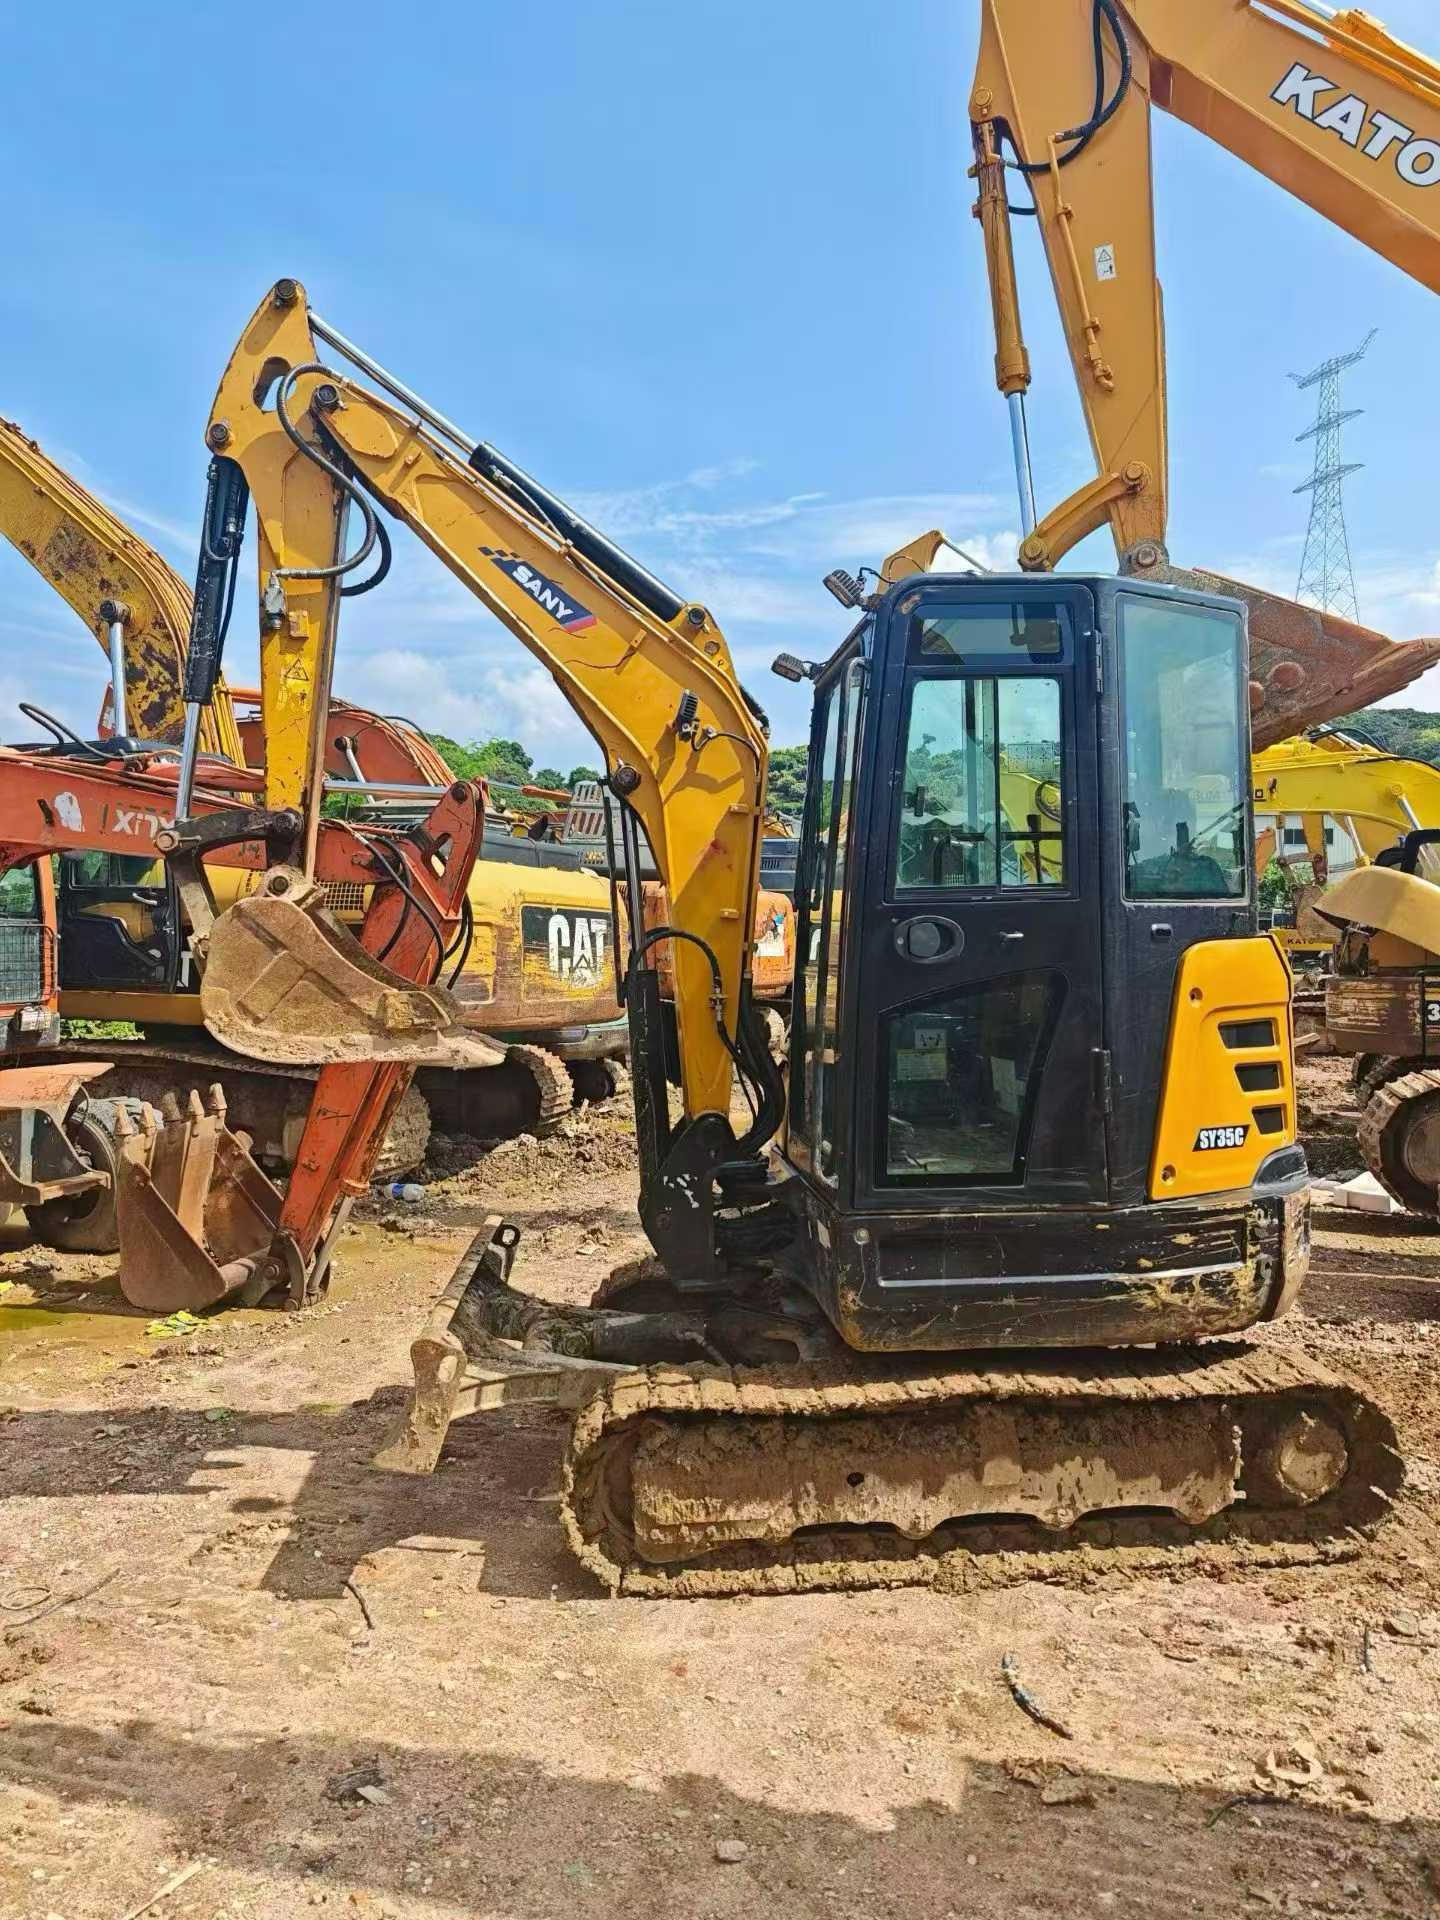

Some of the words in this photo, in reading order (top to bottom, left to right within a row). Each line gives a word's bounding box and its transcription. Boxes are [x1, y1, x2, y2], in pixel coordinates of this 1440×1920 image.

[1270, 62, 1440, 187] KATO
[512, 565, 574, 620] SANY
[548, 914, 608, 983] CAT
[1200, 1127, 1244, 1149] SY35C
